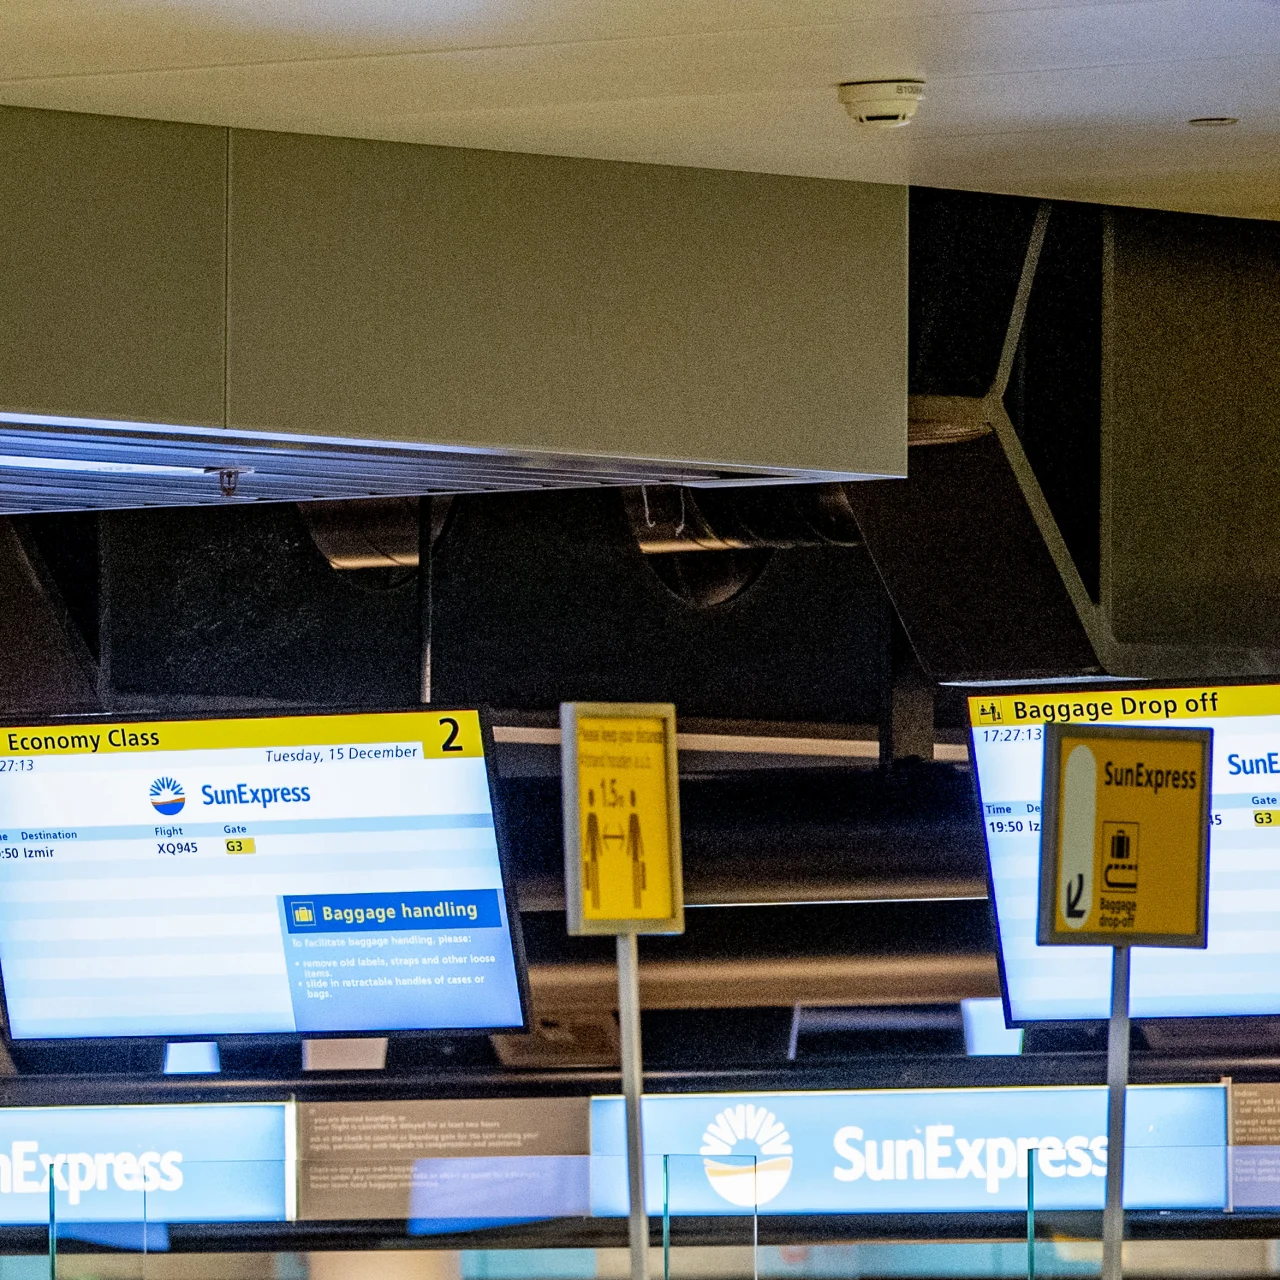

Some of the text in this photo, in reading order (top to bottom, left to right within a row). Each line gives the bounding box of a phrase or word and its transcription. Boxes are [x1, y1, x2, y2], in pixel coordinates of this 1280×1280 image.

[1014, 692, 1219, 722] Baggage Drop off
[7, 727, 160, 755] Economy Class
[439, 717, 464, 753] 2
[983, 728, 1042, 742] 17:27:13
[265, 745, 418, 765] Tuesday, 15 December
[1104, 761, 1197, 794] SunExpress
[201, 780, 311, 810] SunExpress
[1251, 795, 1277, 805] Gate
[986, 805, 1012, 814] Time
[1254, 813, 1273, 824] G3
[20, 829, 78, 841] Destination
[154, 825, 183, 838] Flight
[223, 824, 247, 834] Gate
[989, 821, 1023, 833] 19:50
[23, 845, 55, 859] Izmir
[157, 841, 198, 856] XQ945
[225, 840, 243, 853] G3
[322, 902, 477, 923] Baggage handling
[1099, 897, 1137, 913] Baggage
[833, 1125, 1109, 1193] SunExpress
